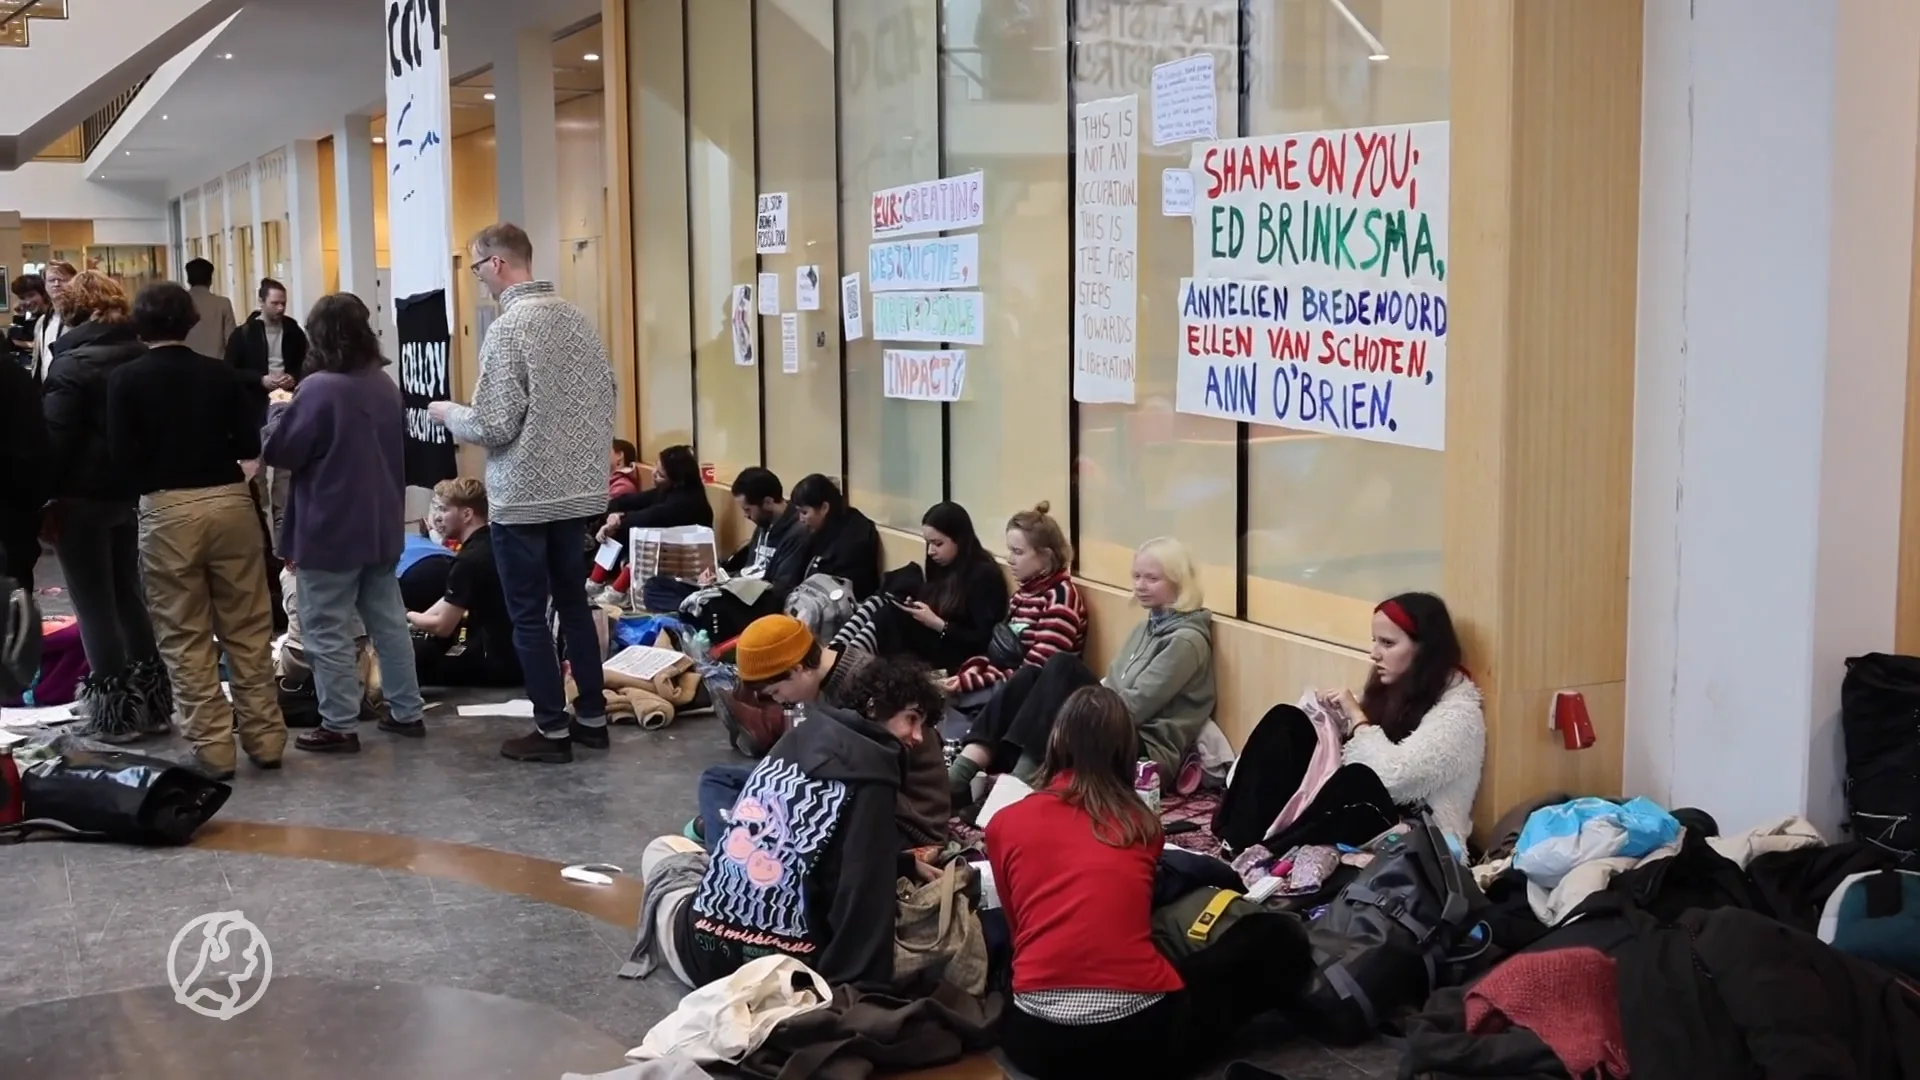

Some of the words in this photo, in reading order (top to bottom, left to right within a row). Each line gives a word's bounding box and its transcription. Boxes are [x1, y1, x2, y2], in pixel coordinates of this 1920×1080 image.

[1081, 112, 1110, 139] THIS
[1118, 109, 1133, 137] IS
[1084, 145, 1104, 173] NOT
[1109, 141, 1127, 170] AN
[1204, 139, 1300, 199] SHAME
[1308, 133, 1347, 195] ON
[903, 181, 980, 223] CREATING
[1080, 210, 1104, 240] THIS
[1109, 215, 1122, 241] IS
[1212, 205, 1244, 259] ED
[1257, 200, 1445, 280] BRINKSMA,
[1079, 246, 1102, 274] THE
[1107, 246, 1134, 281] FIRST
[1079, 281, 1111, 310] STEPS
[1184, 281, 1288, 321] ANNELIEN
[1302, 285, 1447, 337] BREDENOORD
[1082, 313, 1132, 344] TOWARDS
[1187, 324, 1252, 358] ELLEN
[1267, 326, 1310, 363] VAN
[1317, 330, 1433, 385] SCHOTEN,
[1205, 362, 1257, 416] ANN
[1273, 363, 1397, 432] O'BRIEN.
